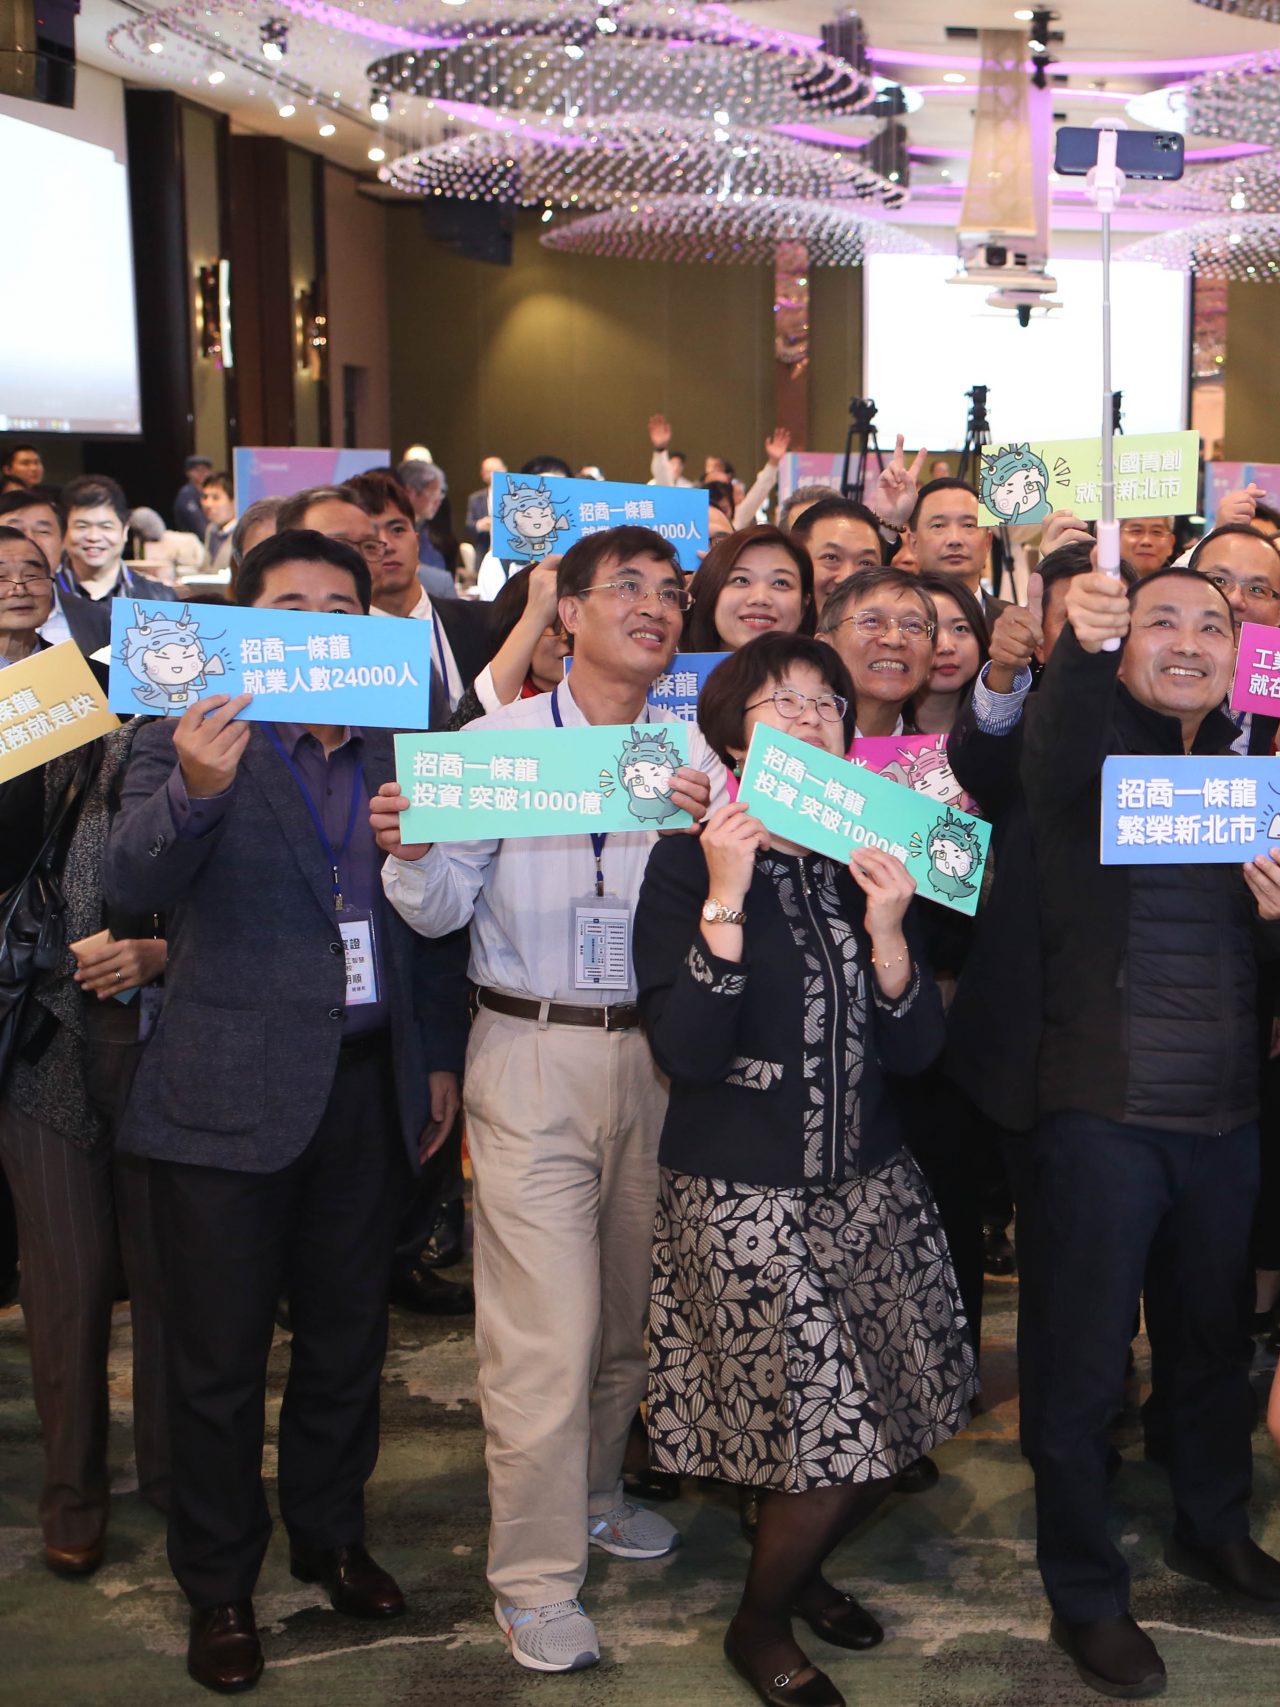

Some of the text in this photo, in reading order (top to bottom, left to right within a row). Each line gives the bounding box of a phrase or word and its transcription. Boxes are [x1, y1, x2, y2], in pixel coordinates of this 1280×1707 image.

[1097, 449, 1181, 476] 國青創
[579, 500, 655, 522] 招商一條龍
[240, 635, 351, 664] 招商一條龍
[242, 662, 419, 695] 就業人數24000人
[413, 751, 540, 782] 招商一條龍
[762, 745, 866, 816] 招商一條龍
[412, 782, 603, 815] 投資 突破1000億
[753, 770, 799, 808] 投資
[1117, 778, 1257, 808] 招商一條龍
[1116, 814, 1257, 845] 繁榮新北市
